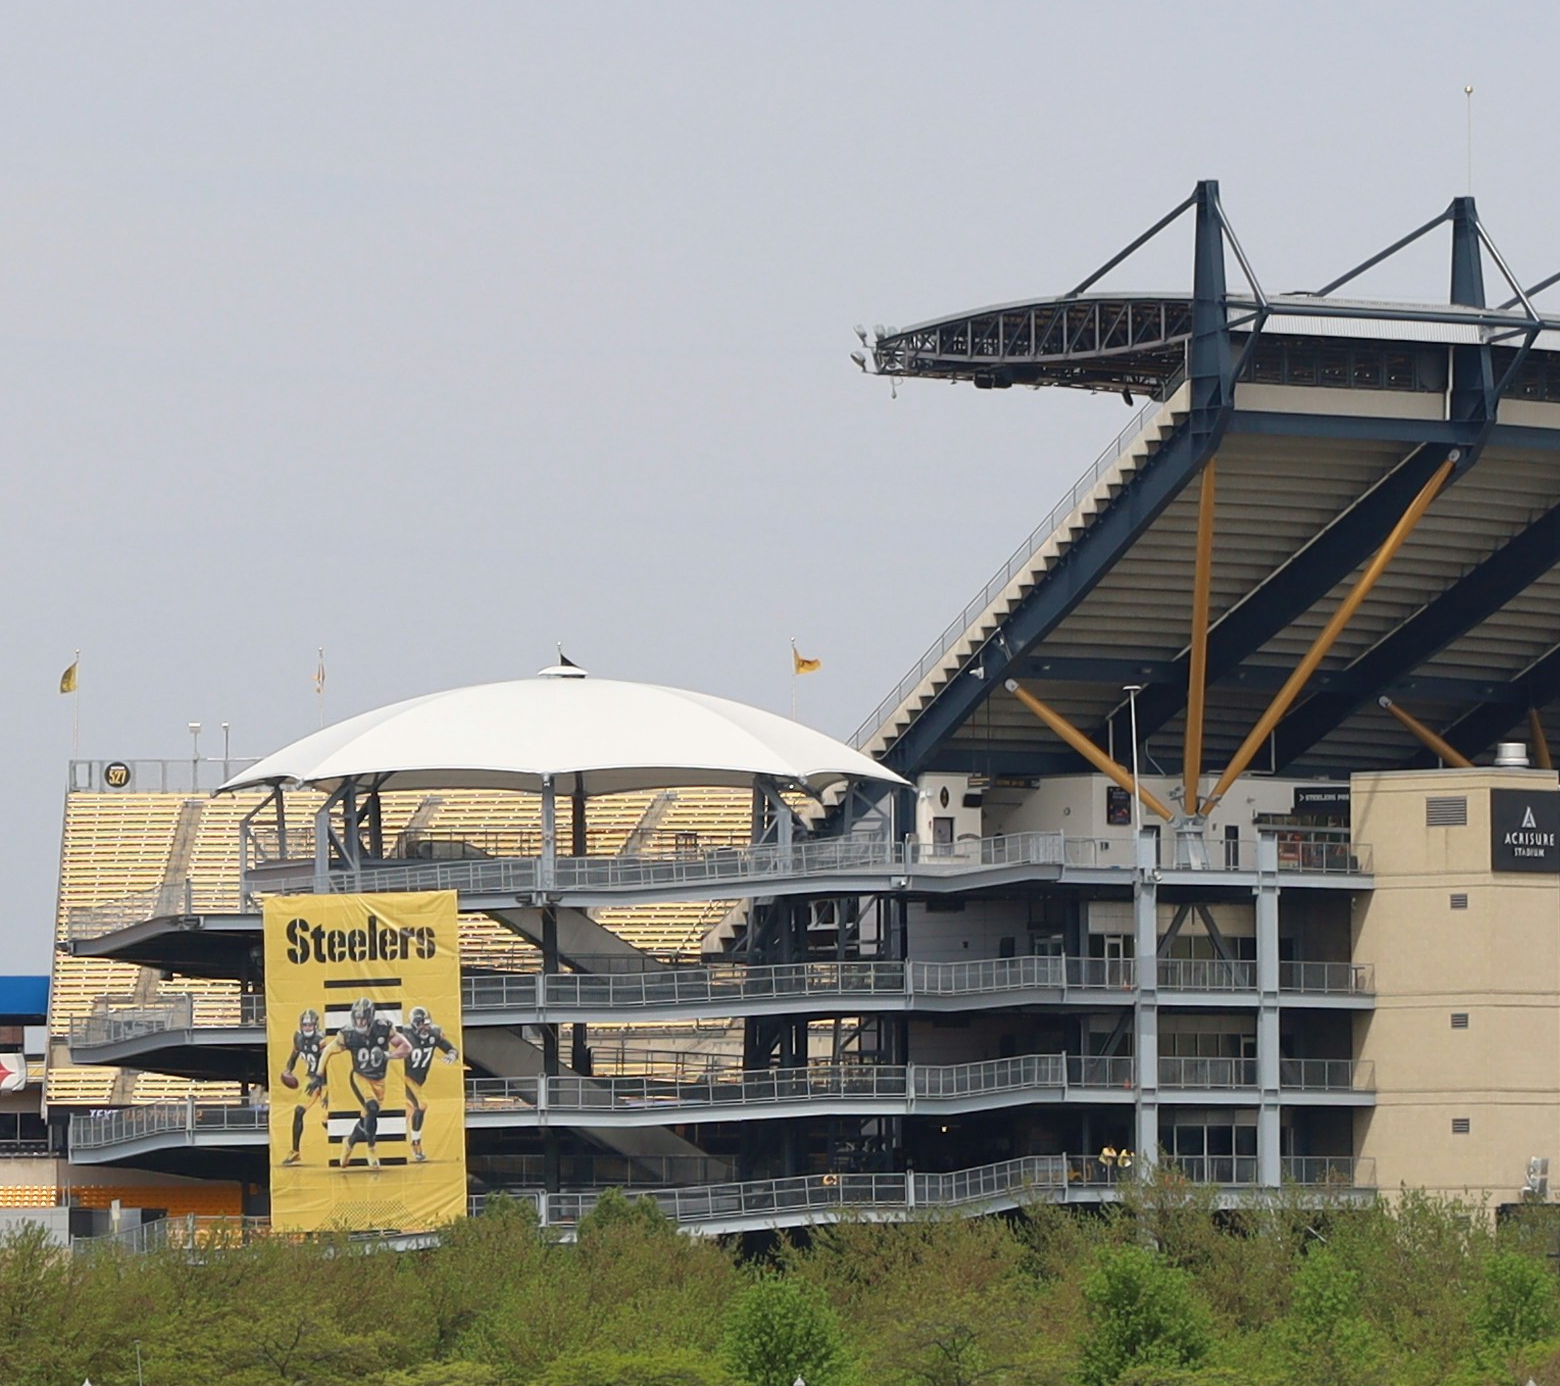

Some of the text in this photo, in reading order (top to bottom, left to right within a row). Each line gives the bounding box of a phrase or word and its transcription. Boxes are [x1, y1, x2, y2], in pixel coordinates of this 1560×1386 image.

[109, 770, 126, 784] 527
[1504, 831, 1555, 847] ACRISURE
[1514, 848, 1545, 858] STADIUM
[286, 915, 436, 964] Steelers
[411, 1046, 433, 1069] 97
